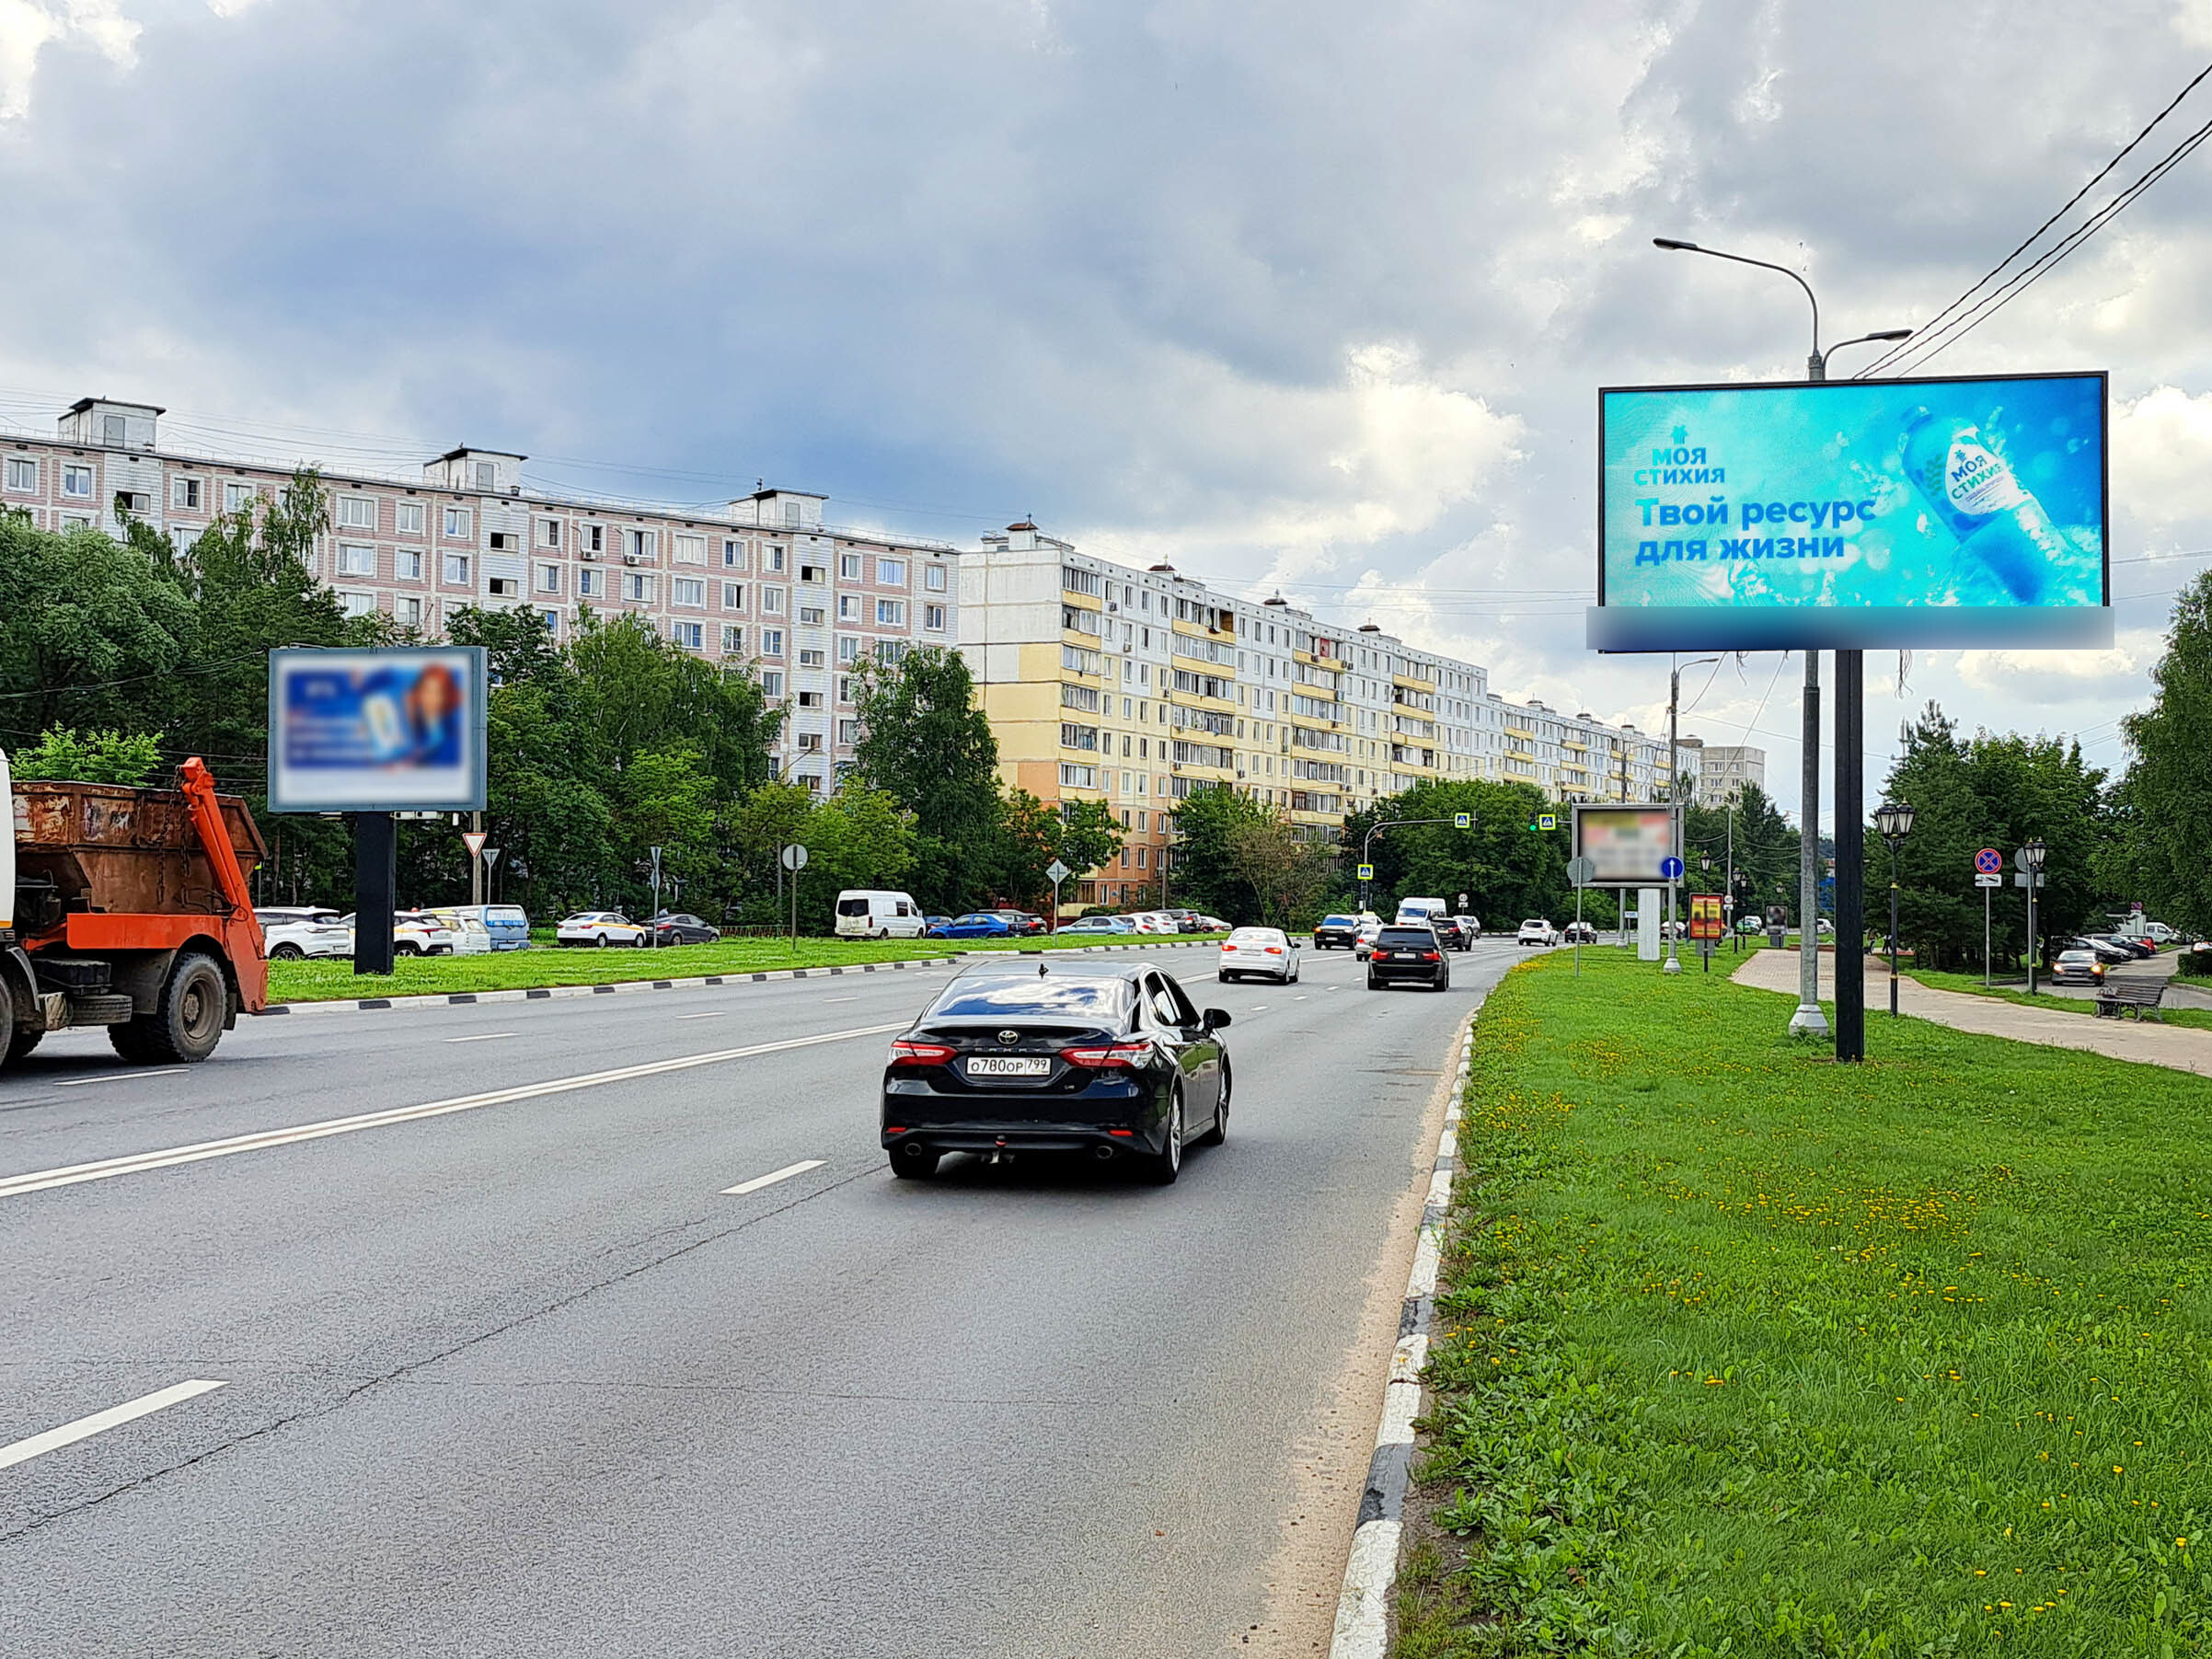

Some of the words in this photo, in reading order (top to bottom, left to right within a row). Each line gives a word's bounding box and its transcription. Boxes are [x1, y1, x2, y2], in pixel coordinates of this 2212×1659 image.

[1652, 447, 1707, 466] МОЯ
[1951, 455, 1987, 482] МОЯ
[1633, 467, 1725, 486] СТИХИЯ
[1635, 495, 1728, 526] Твой
[1742, 500, 1876, 531] ресурс
[1635, 539, 1707, 566] для
[1719, 536, 1845, 560] жизни
